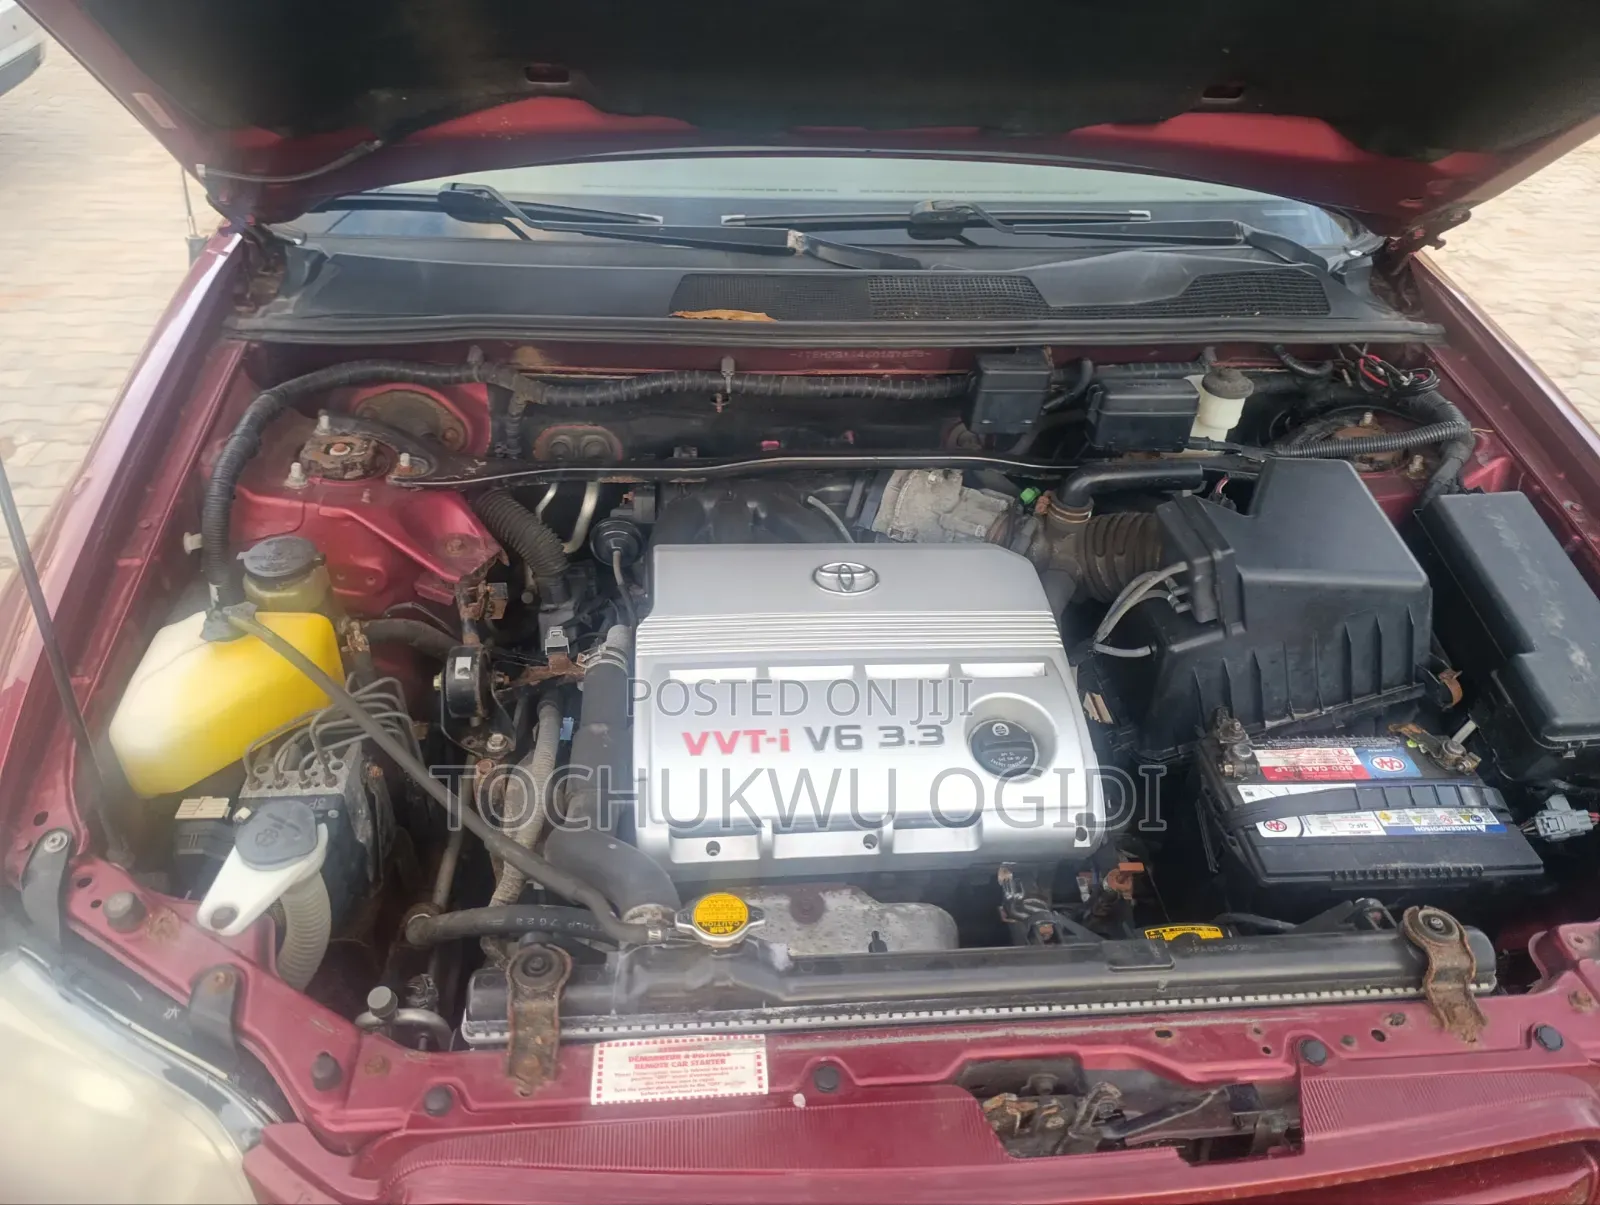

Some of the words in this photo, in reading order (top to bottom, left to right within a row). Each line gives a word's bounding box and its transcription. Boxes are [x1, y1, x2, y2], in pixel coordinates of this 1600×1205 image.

[682, 728, 791, 756] VVT-i
[803, 724, 863, 752] V6
[877, 724, 946, 747] 3.3
[1375, 758, 1403, 770] CAA
[1266, 820, 1287, 831] CAA
[671, 1060, 689, 1068] CAR
[690, 1058, 726, 1067] STARTER
